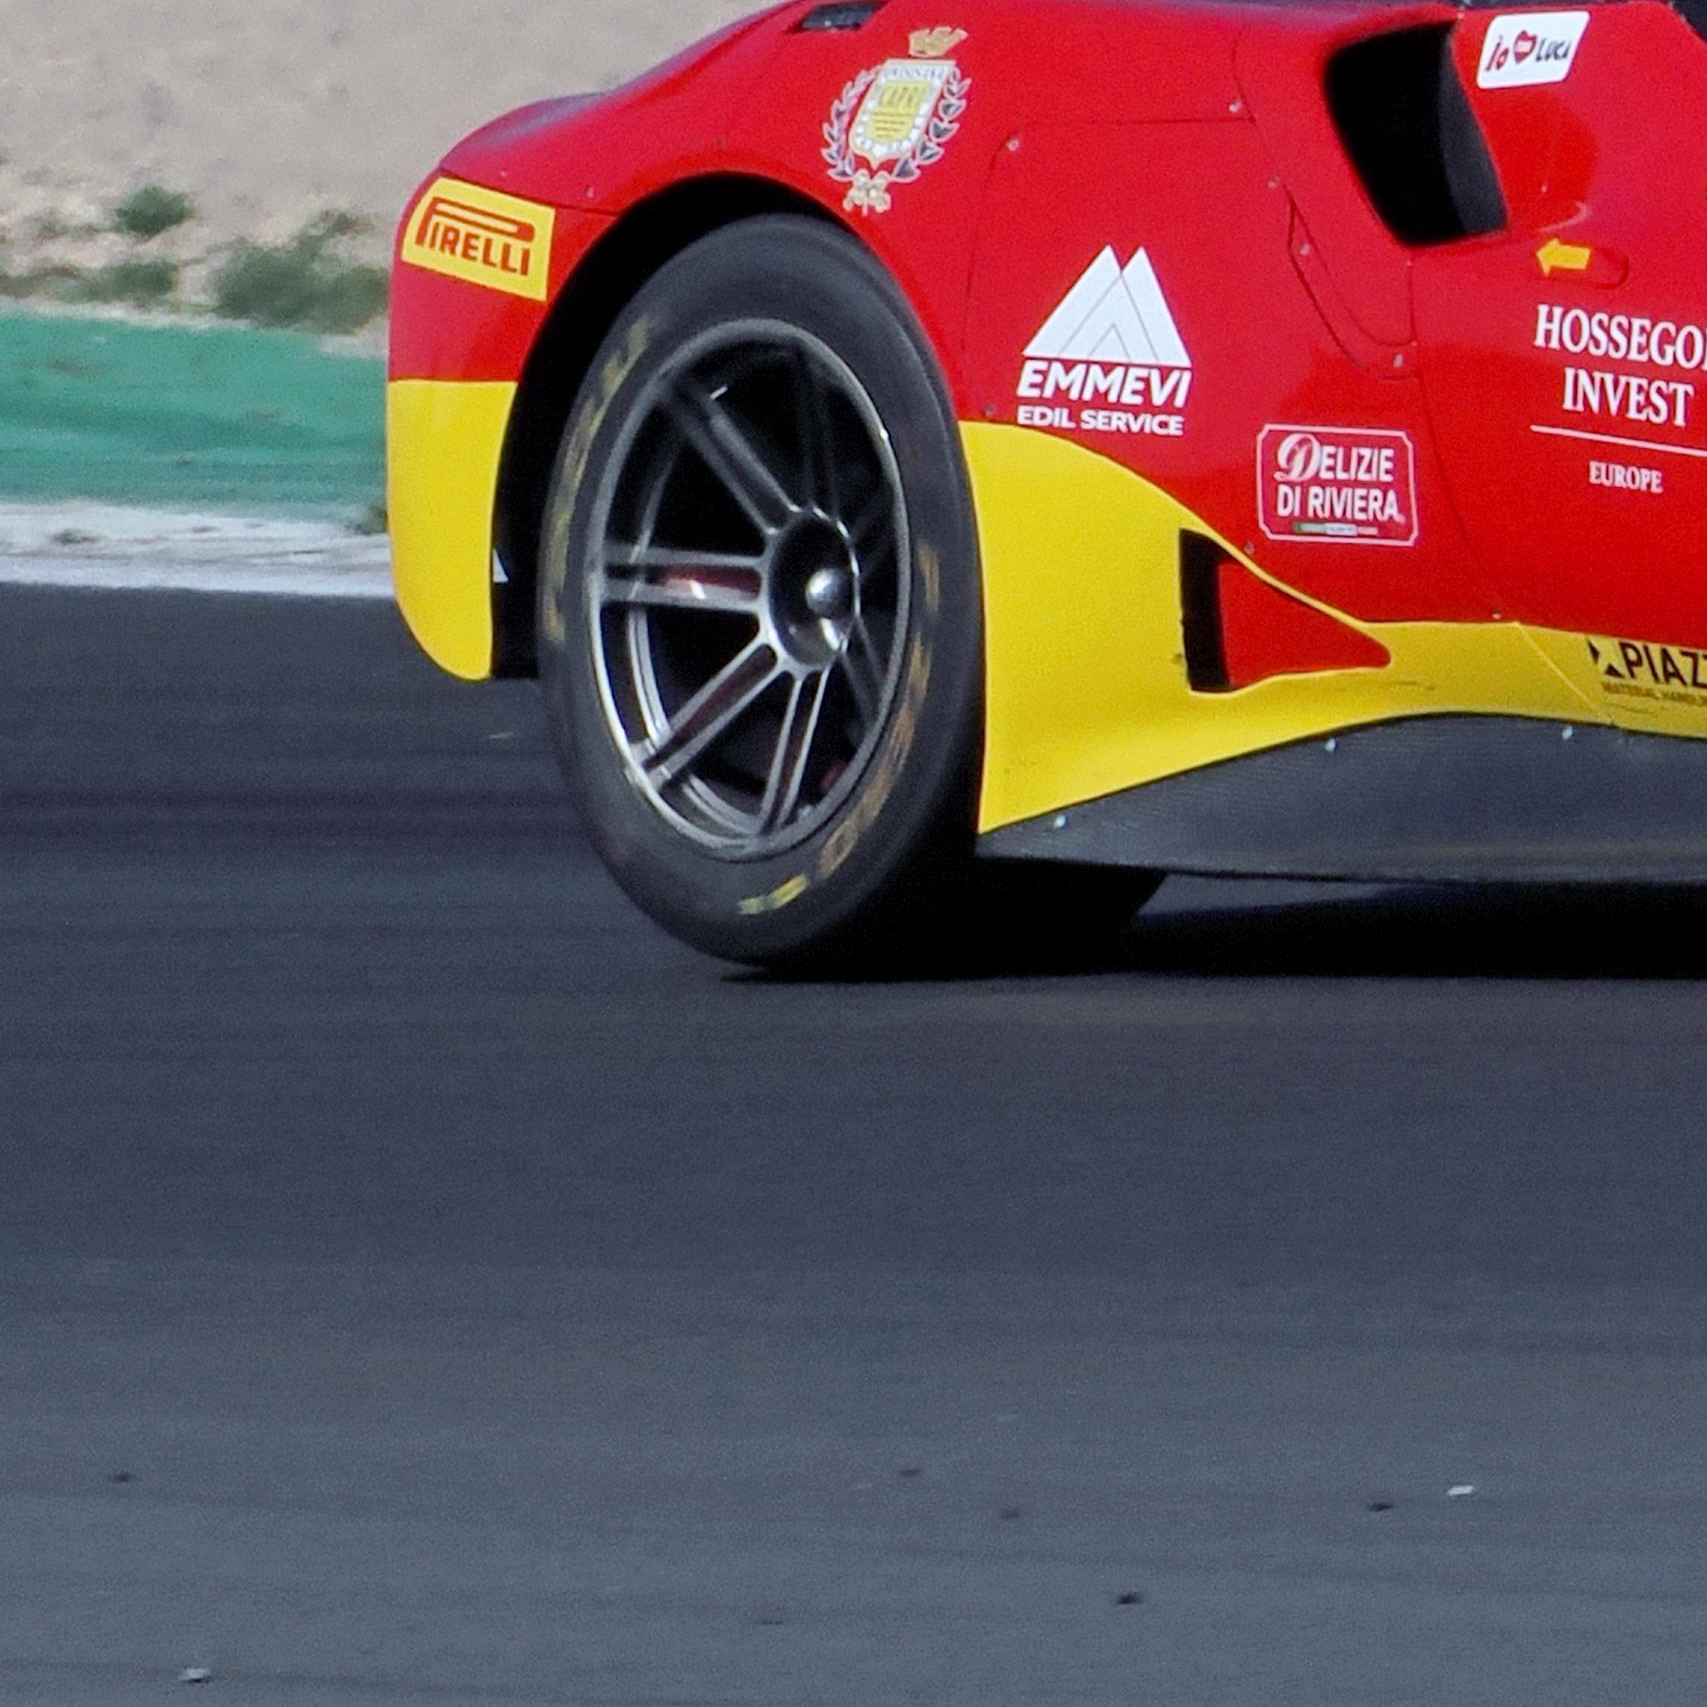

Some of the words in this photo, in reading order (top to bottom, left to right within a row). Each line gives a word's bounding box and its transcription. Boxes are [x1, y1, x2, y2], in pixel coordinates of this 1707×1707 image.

[415, 196, 535, 277] PIRELLI
[1016, 359, 1192, 408] EMMEVI
[1562, 367, 1694, 427] INVEST
[1017, 404, 1077, 428] EDIL
[1080, 409, 1185, 436] SERVICE
[1273, 432, 1395, 482] DELIZIE
[1589, 460, 1663, 493] EUROPE
[1277, 483, 1301, 517] DI
[1307, 485, 1402, 523] RIVIERA
